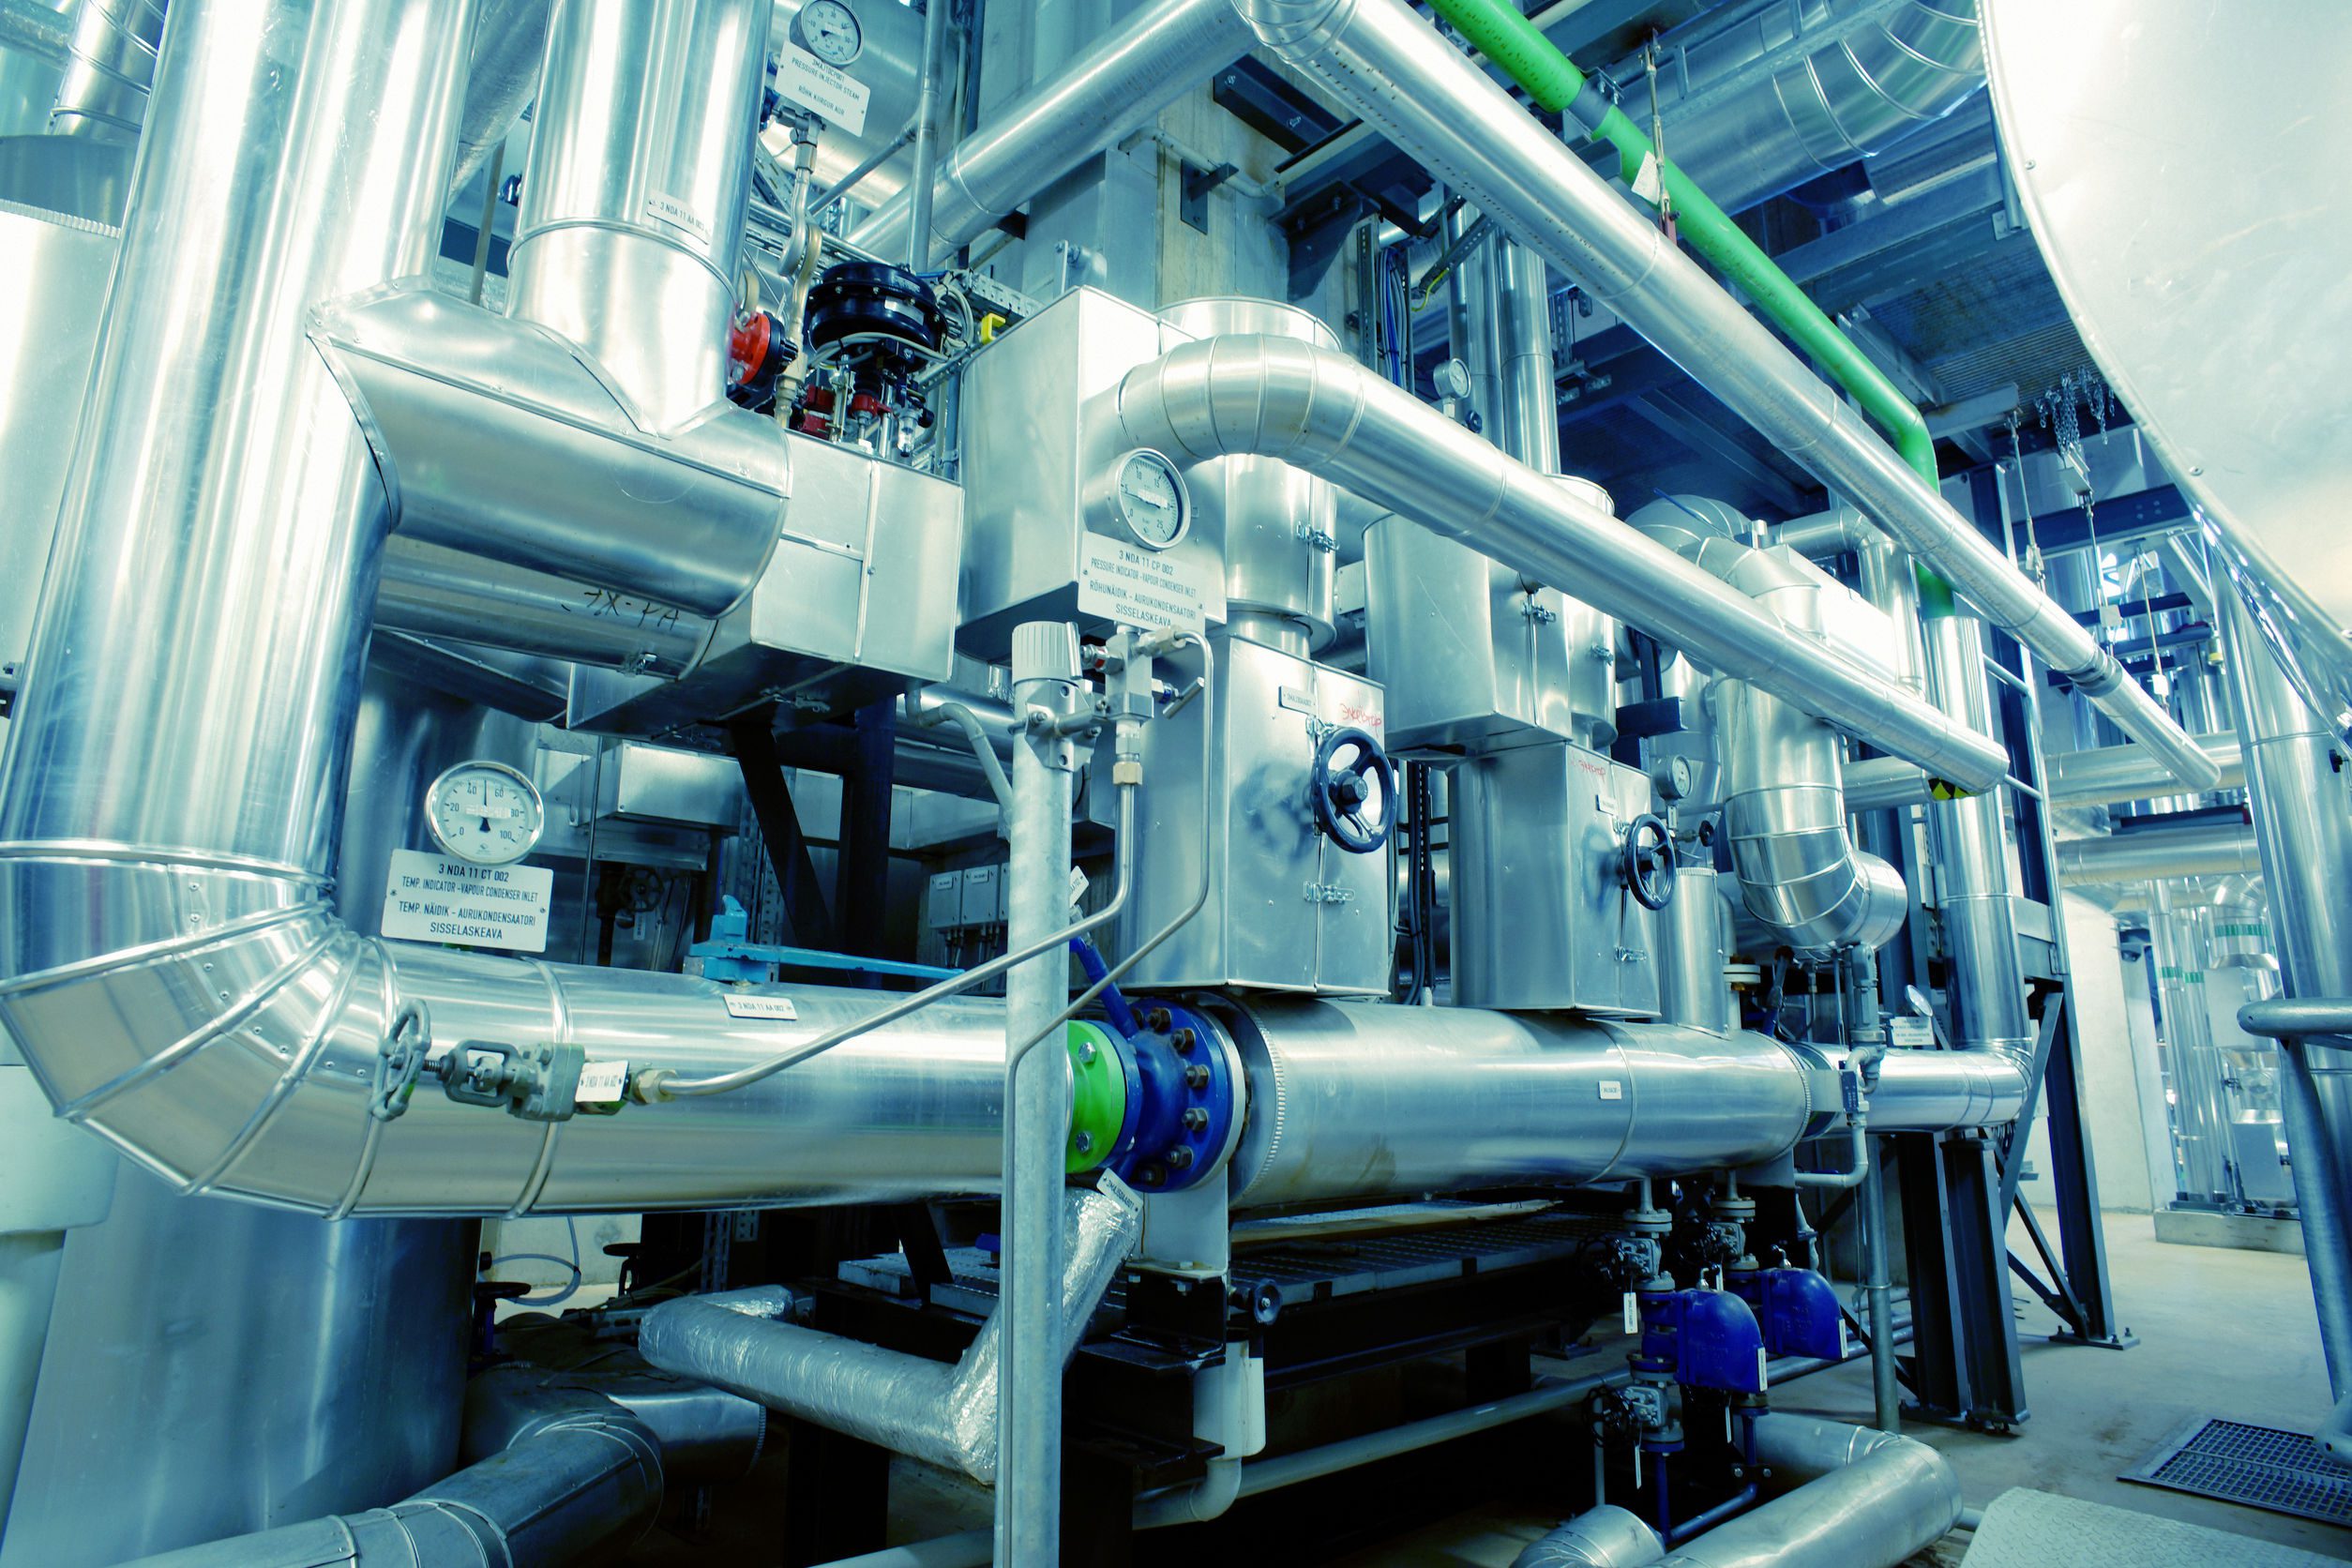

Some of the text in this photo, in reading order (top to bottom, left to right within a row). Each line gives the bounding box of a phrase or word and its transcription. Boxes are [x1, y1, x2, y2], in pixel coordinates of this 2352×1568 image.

[792, 57, 860, 101] PRESSURE INJECTOR STEAM
[666, 203, 678, 217] NDA
[680, 210, 686, 220] 11
[687, 215, 695, 225] AA
[1119, 550, 1173, 576] 3 NDA 11 CP 002
[1091, 558, 1115, 574] PRESSURE
[1116, 565, 1138, 580] INDICATOR
[1160, 577, 1184, 595] CONDENSER
[1184, 585, 1197, 597] INLET
[1090, 579, 1127, 600] RÕHUNÄIDIK
[1134, 593, 1196, 619] AURUKONDENSAATORI
[1116, 603, 1171, 626] SISSELASKEAVA
[467, 786, 476, 794] 40
[495, 789, 504, 797] 60
[450, 803, 460, 811] 20
[460, 826, 464, 836] 0
[500, 830, 512, 839] 100
[439, 864, 509, 882] 3 NDA 11 CT 002
[402, 876, 421, 888] TEMP.
[423, 879, 456, 893] INDICATOR
[486, 886, 520, 901] CONDENSER
[521, 892, 538, 902] INLET
[400, 900, 421, 913] TEMP.
[424, 901, 449, 916] NÄIDIK
[458, 908, 535, 927] AURUKONDENSAATORI
[430, 922, 503, 939] SISSELASKEAVA
